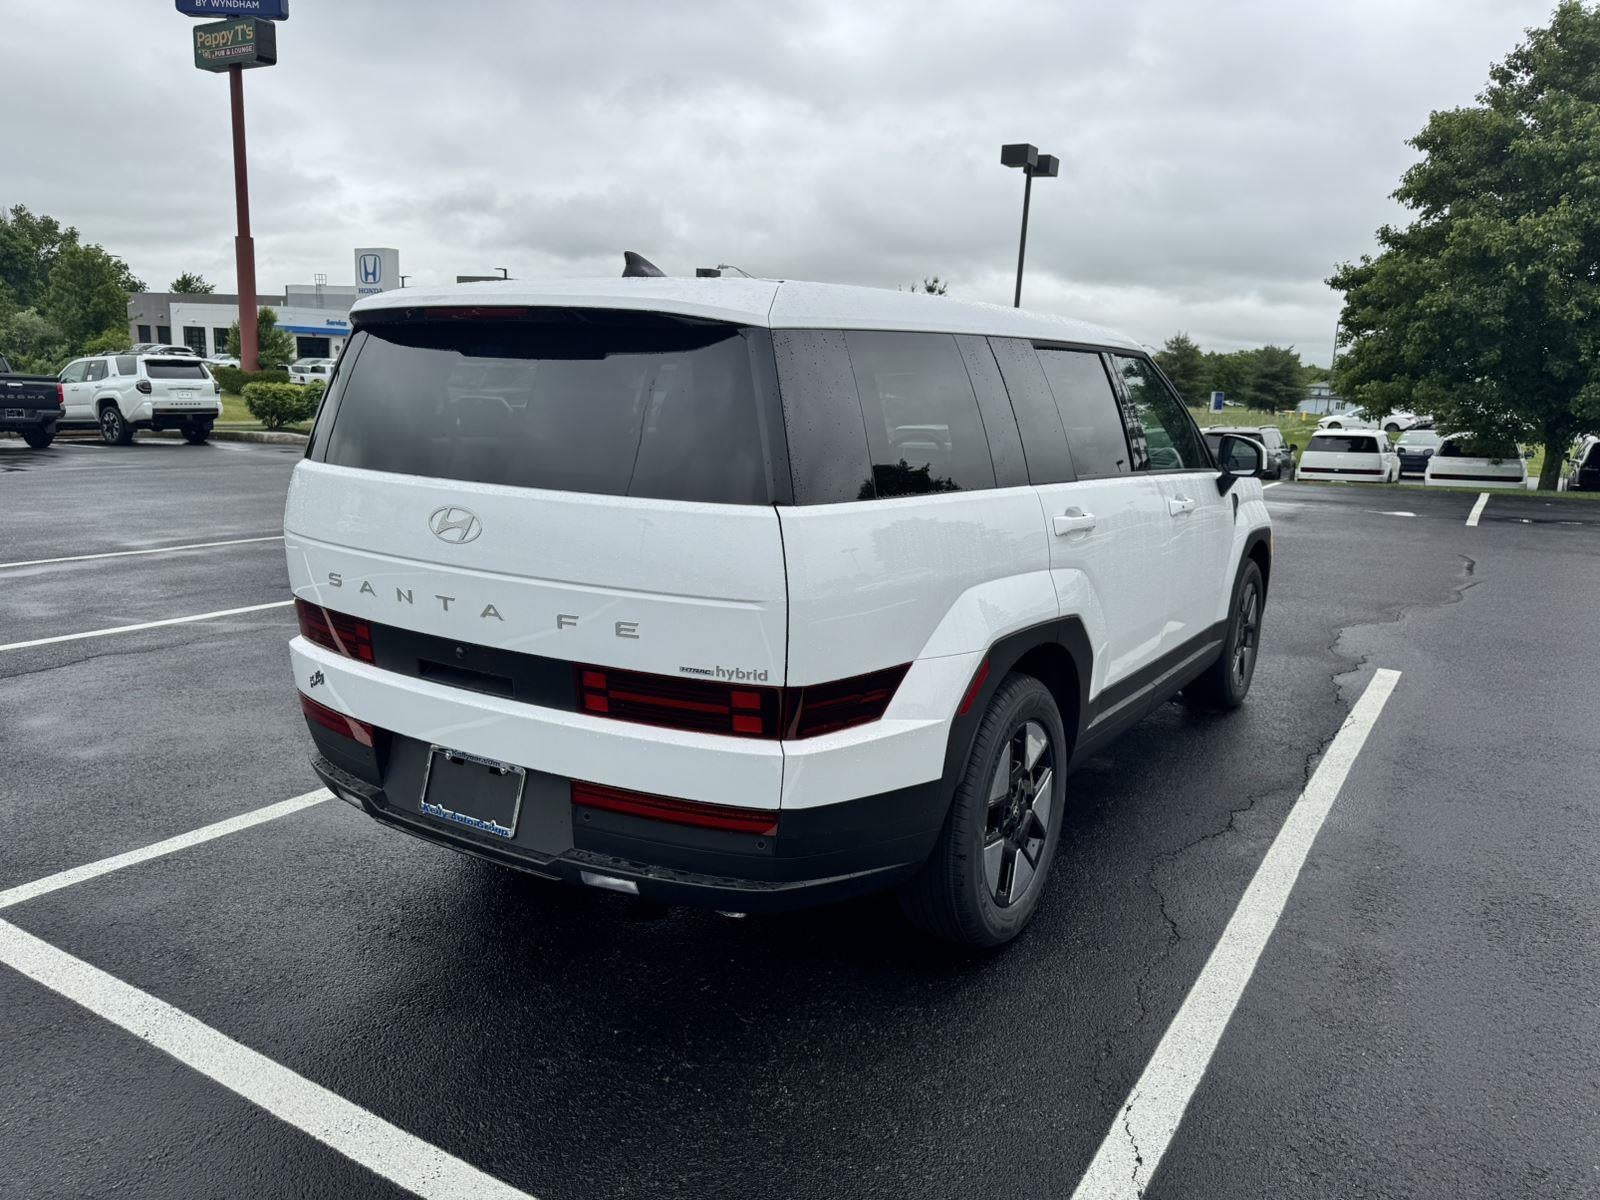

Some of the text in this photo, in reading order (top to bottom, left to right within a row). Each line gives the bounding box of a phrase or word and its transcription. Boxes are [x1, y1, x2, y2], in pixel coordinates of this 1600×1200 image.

[211, 0, 260, 9] WYNDHAM
[196, 24, 254, 47] Pappy T's
[231, 46, 253, 55] LOUNGE
[328, 571, 640, 640] SANTA FE
[715, 665, 769, 681] hybrid
